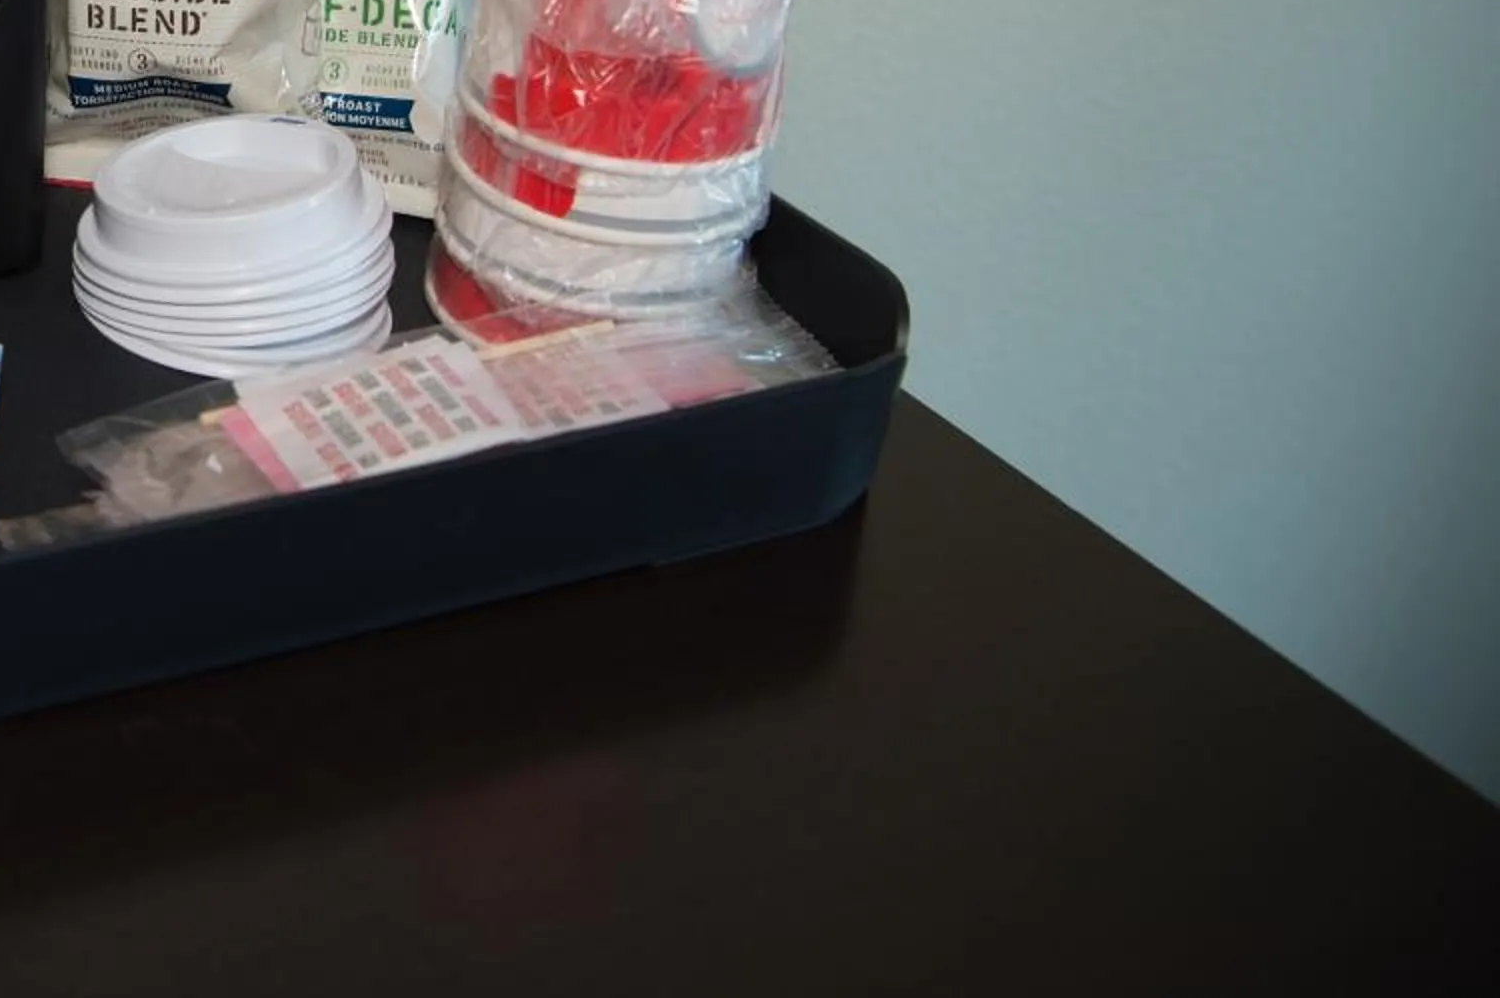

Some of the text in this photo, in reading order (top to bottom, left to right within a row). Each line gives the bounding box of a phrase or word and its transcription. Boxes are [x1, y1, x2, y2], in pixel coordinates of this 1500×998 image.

[87, 3, 201, 37] BLEND
[357, 30, 419, 49] BLEND
[136, 52, 149, 71] 3
[328, 60, 341, 80] 3
